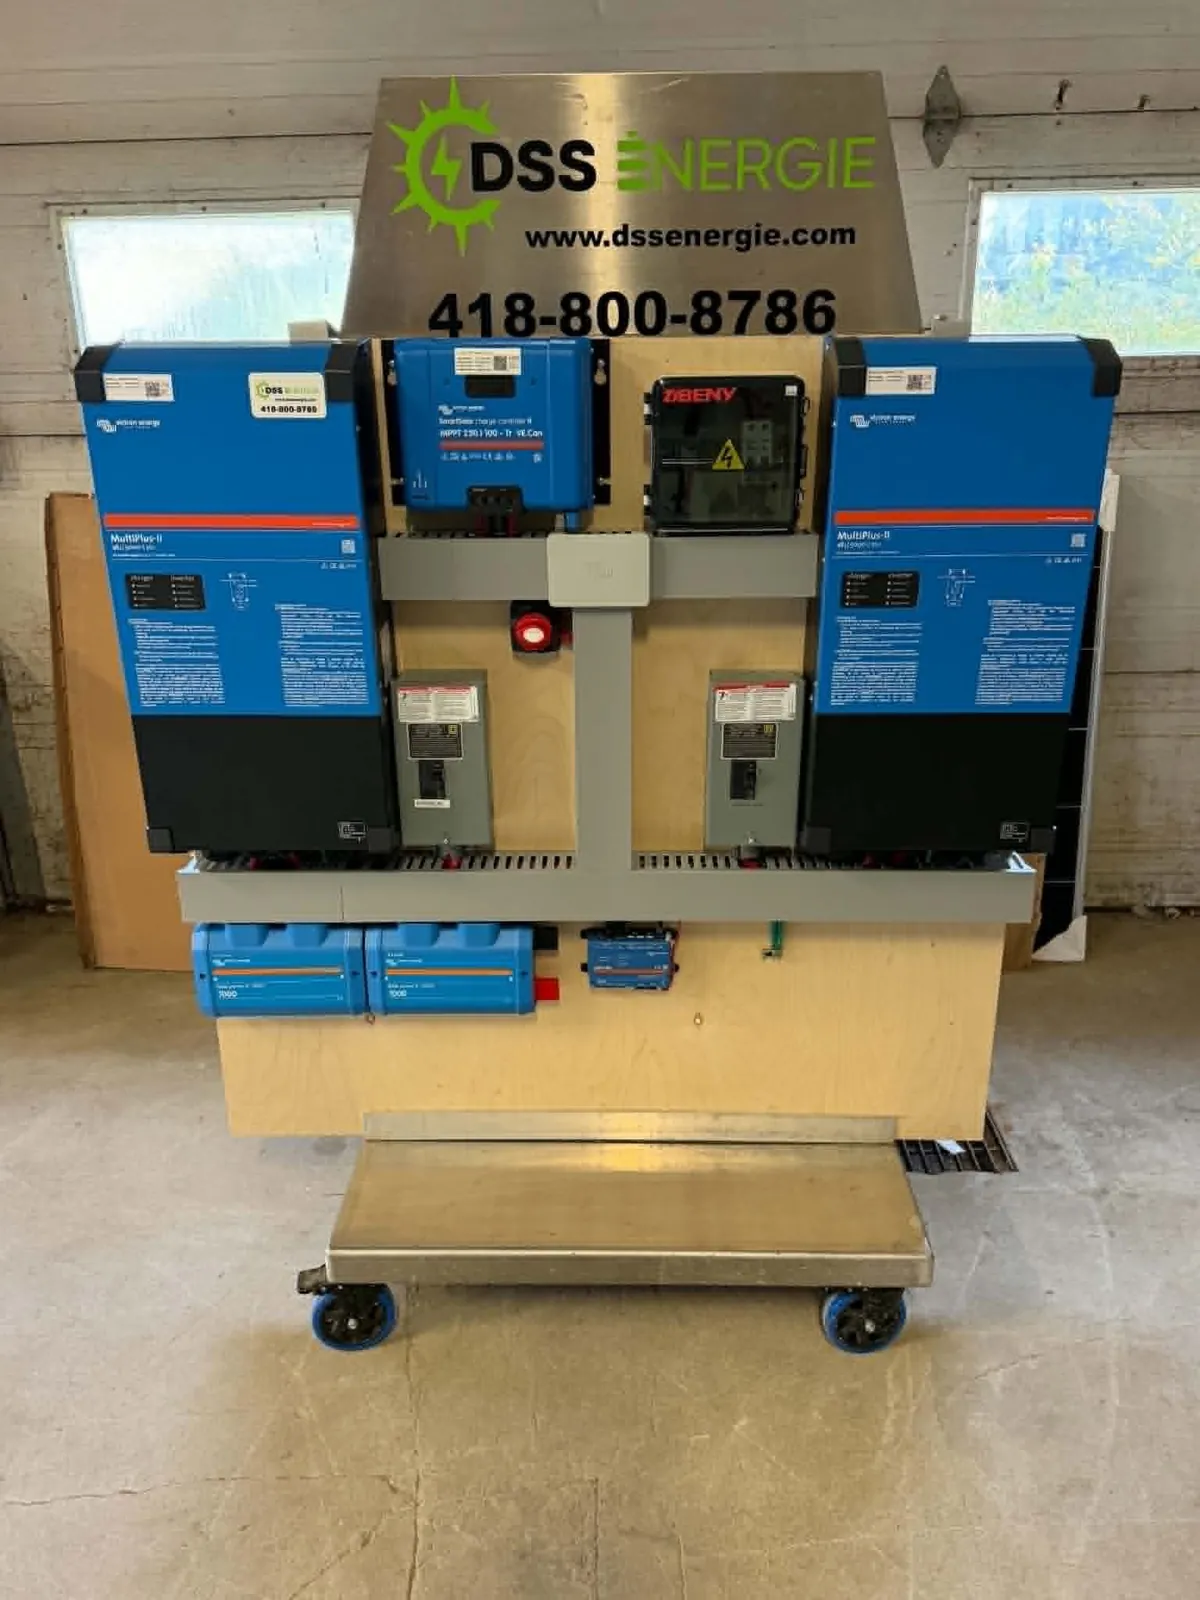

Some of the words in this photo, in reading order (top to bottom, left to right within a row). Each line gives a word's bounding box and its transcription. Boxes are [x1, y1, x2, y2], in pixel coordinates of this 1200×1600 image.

[470, 140, 597, 192] DSS
[525, 223, 857, 252] www.dssenergie.com
[428, 289, 837, 337] 418-800-8786
